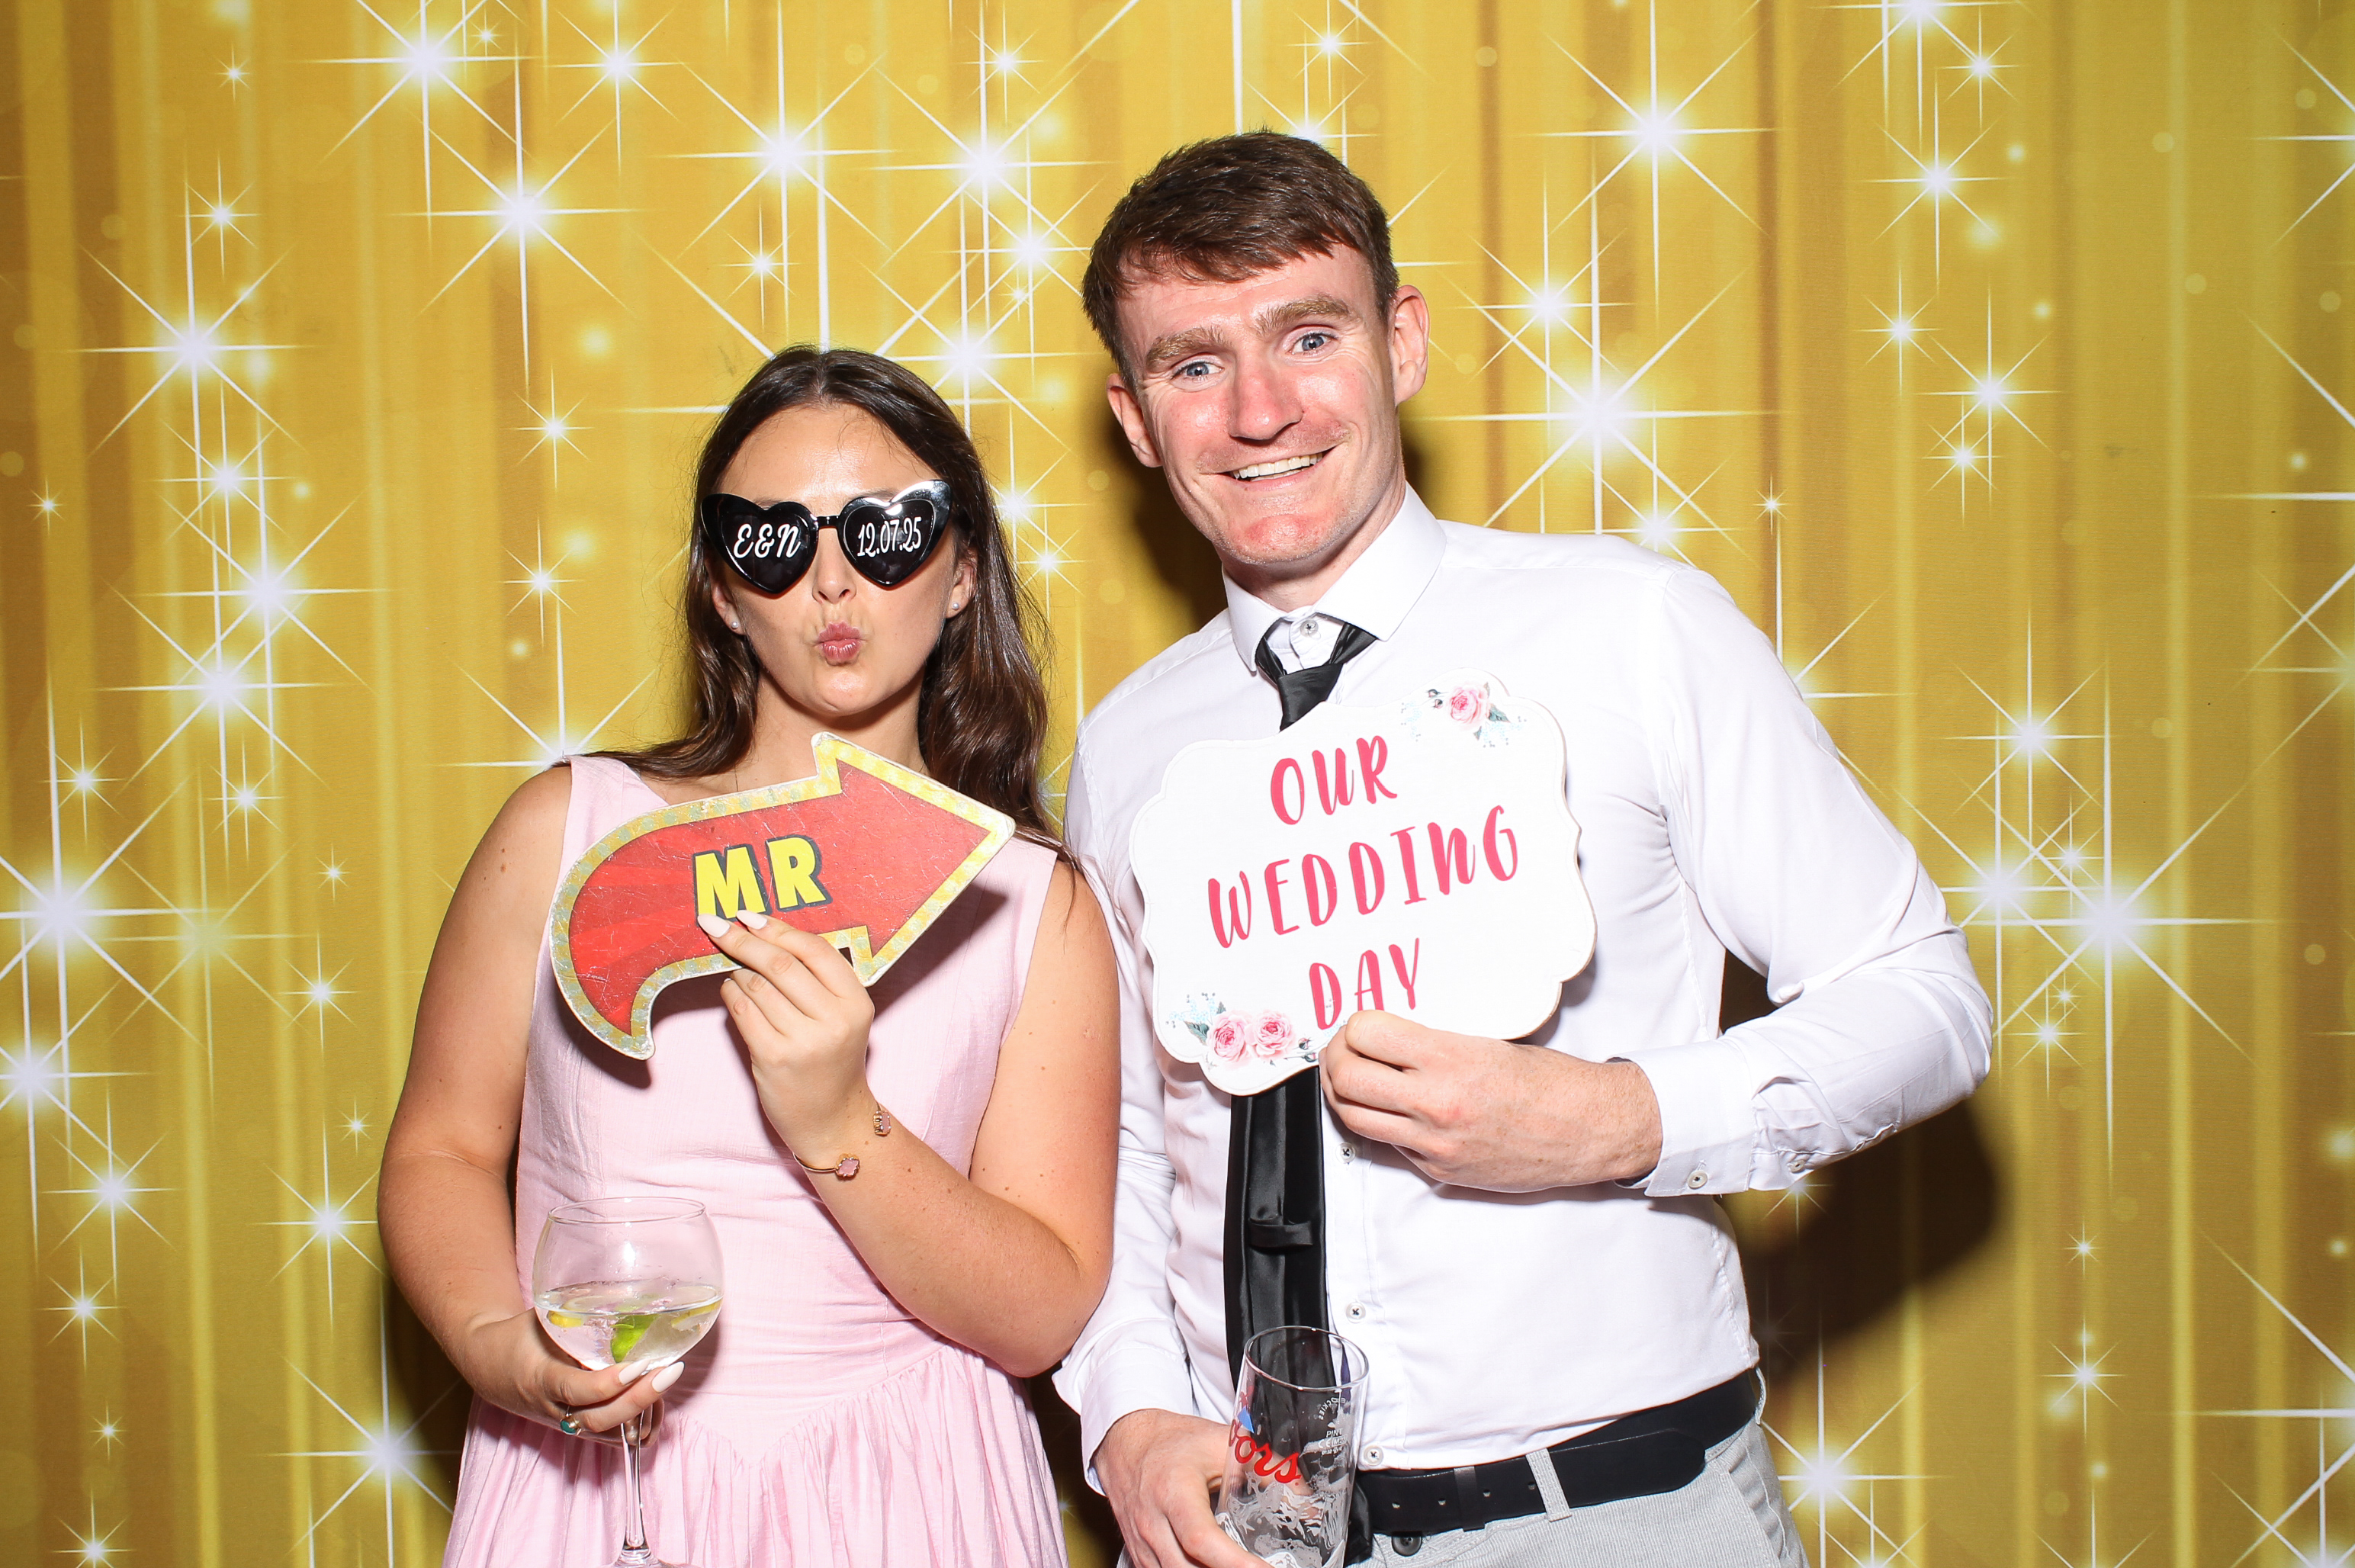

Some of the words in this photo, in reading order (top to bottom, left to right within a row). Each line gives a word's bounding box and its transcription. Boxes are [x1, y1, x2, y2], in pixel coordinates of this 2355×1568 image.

[856, 516, 922, 557] 12.07.25
[1270, 735, 1398, 825] OUR
[693, 836, 831, 920] MR
[1208, 805, 1518, 949] WEDDING
[1309, 938, 1419, 1030] DAY
[1325, 1428, 1343, 1438] PINT
